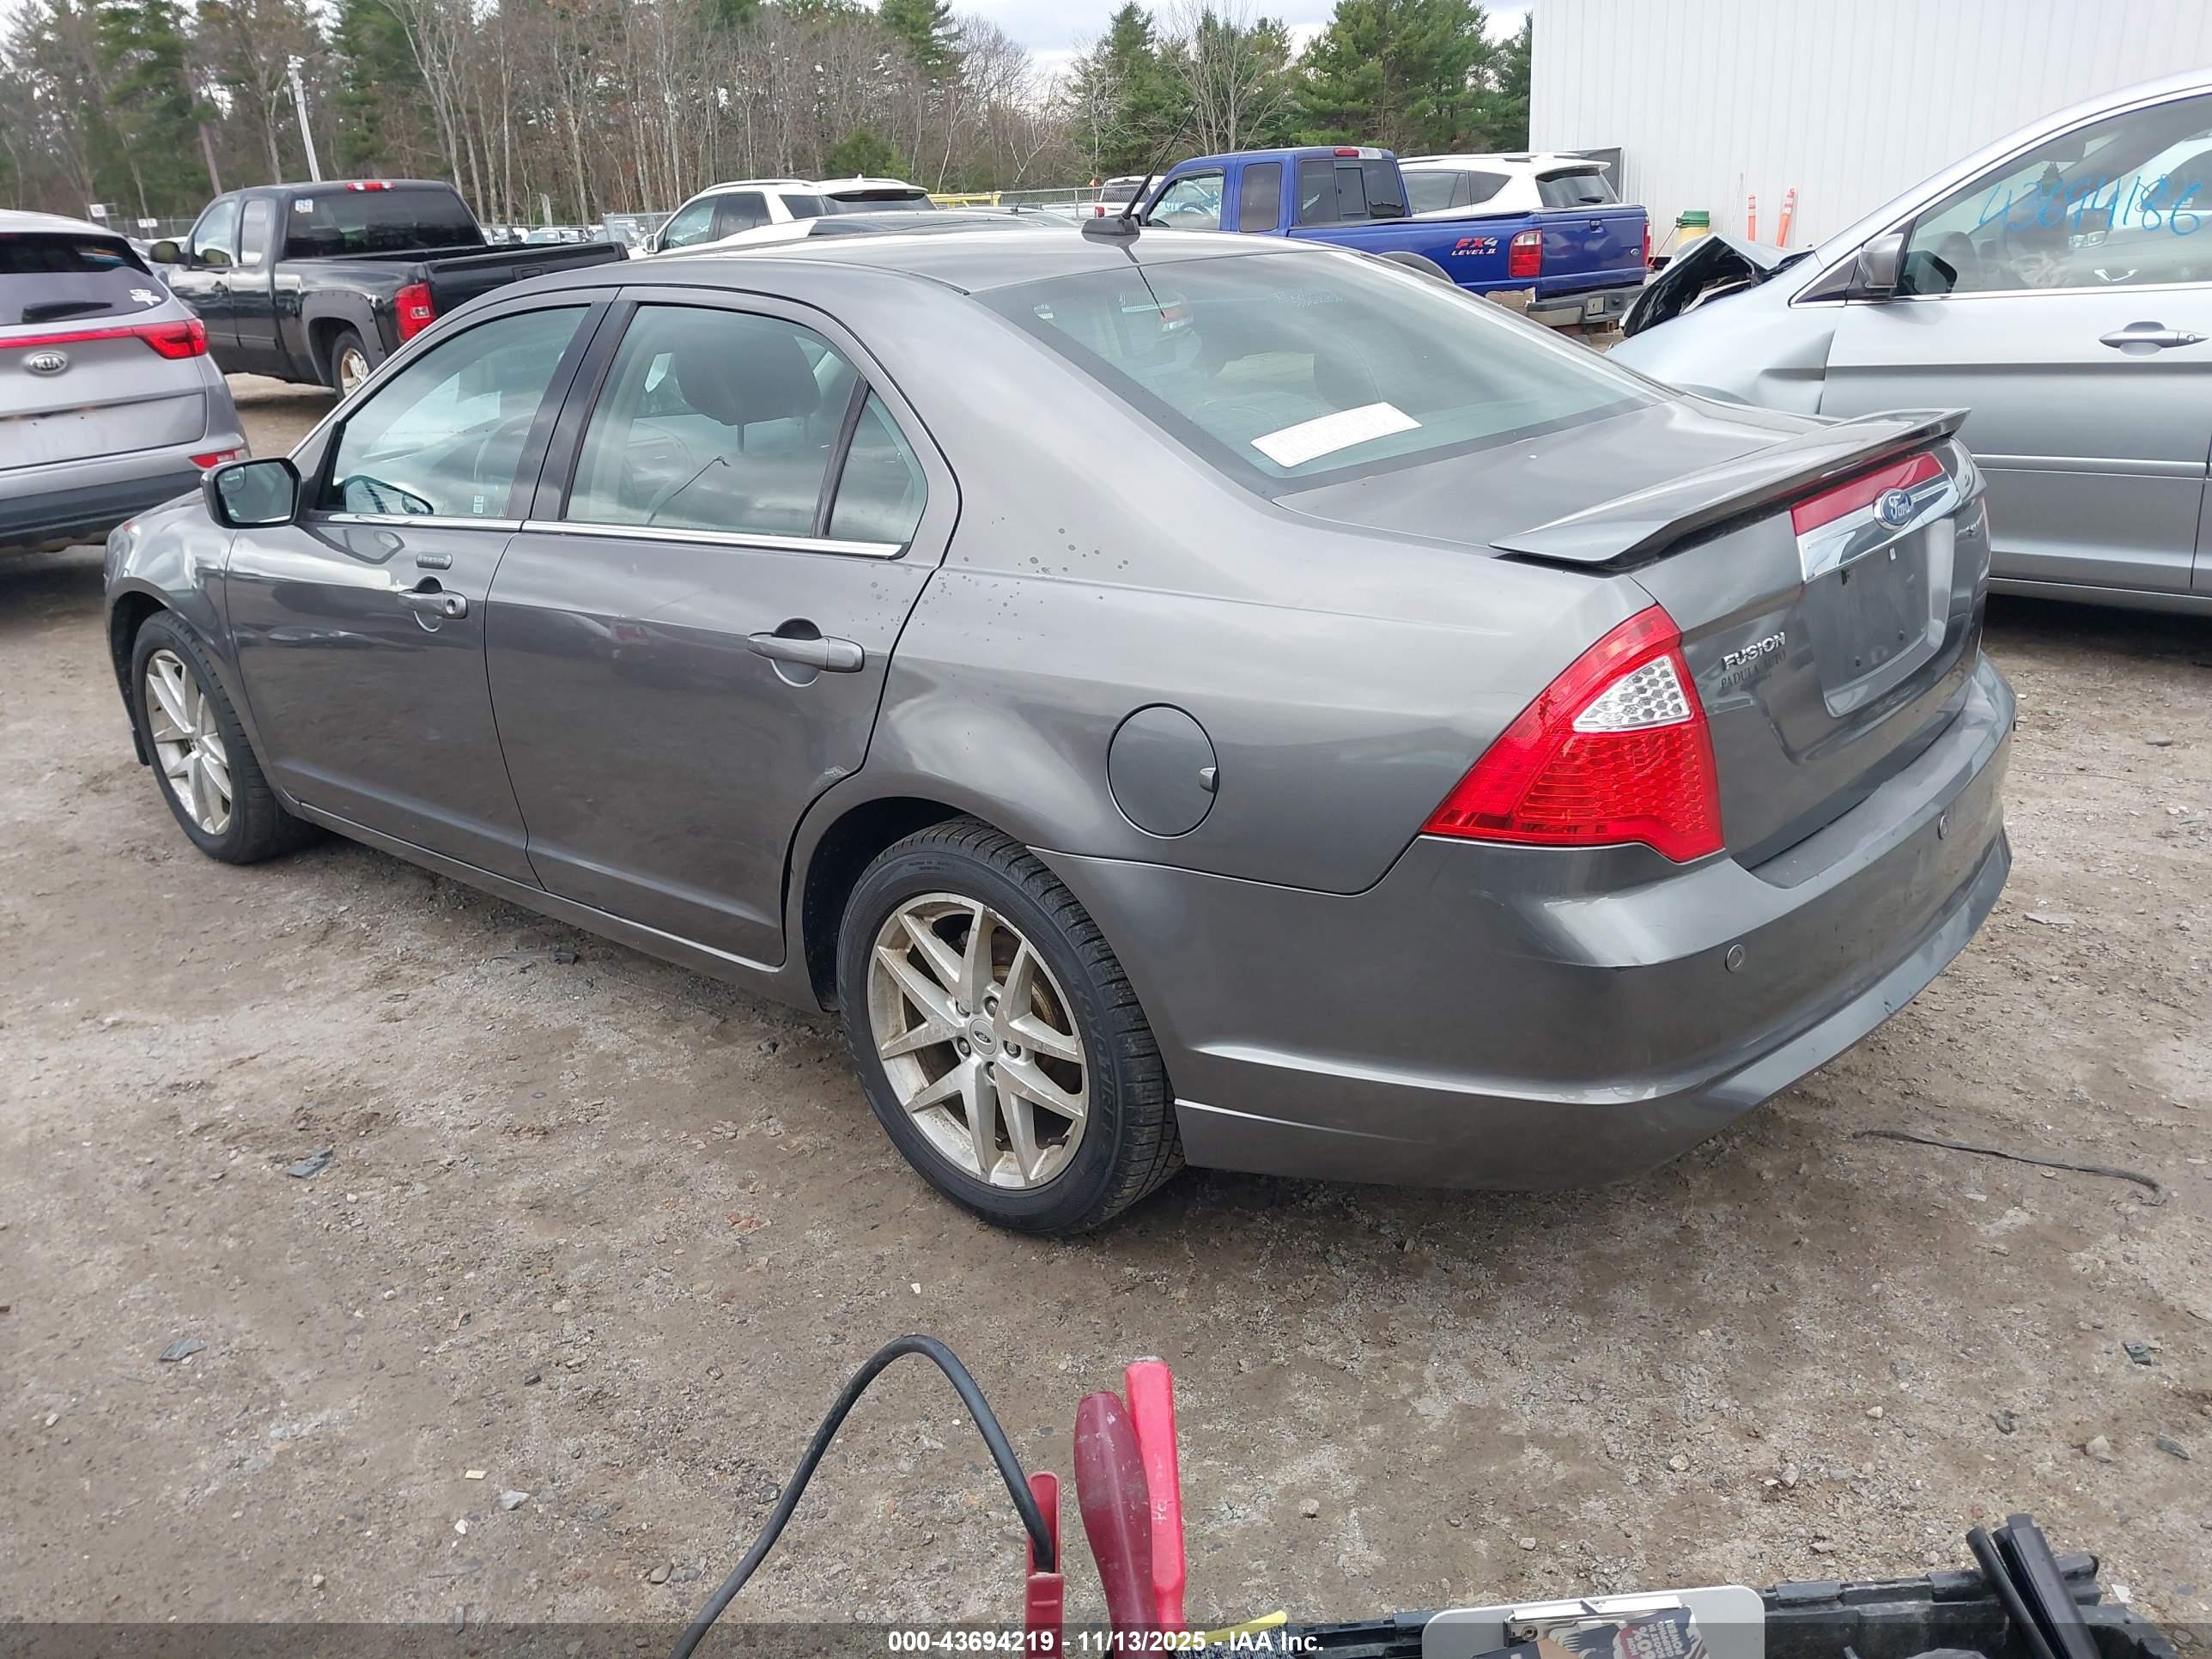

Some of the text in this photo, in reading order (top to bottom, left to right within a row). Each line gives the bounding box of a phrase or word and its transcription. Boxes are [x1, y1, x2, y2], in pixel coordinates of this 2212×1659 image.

[1455, 237, 1498, 248] FX4
[35, 356, 61, 369] KIA
[1888, 494, 1911, 520] Ford
[1722, 631, 1786, 672] FUSION
[1626, 1637, 1639, 1656] NOW
